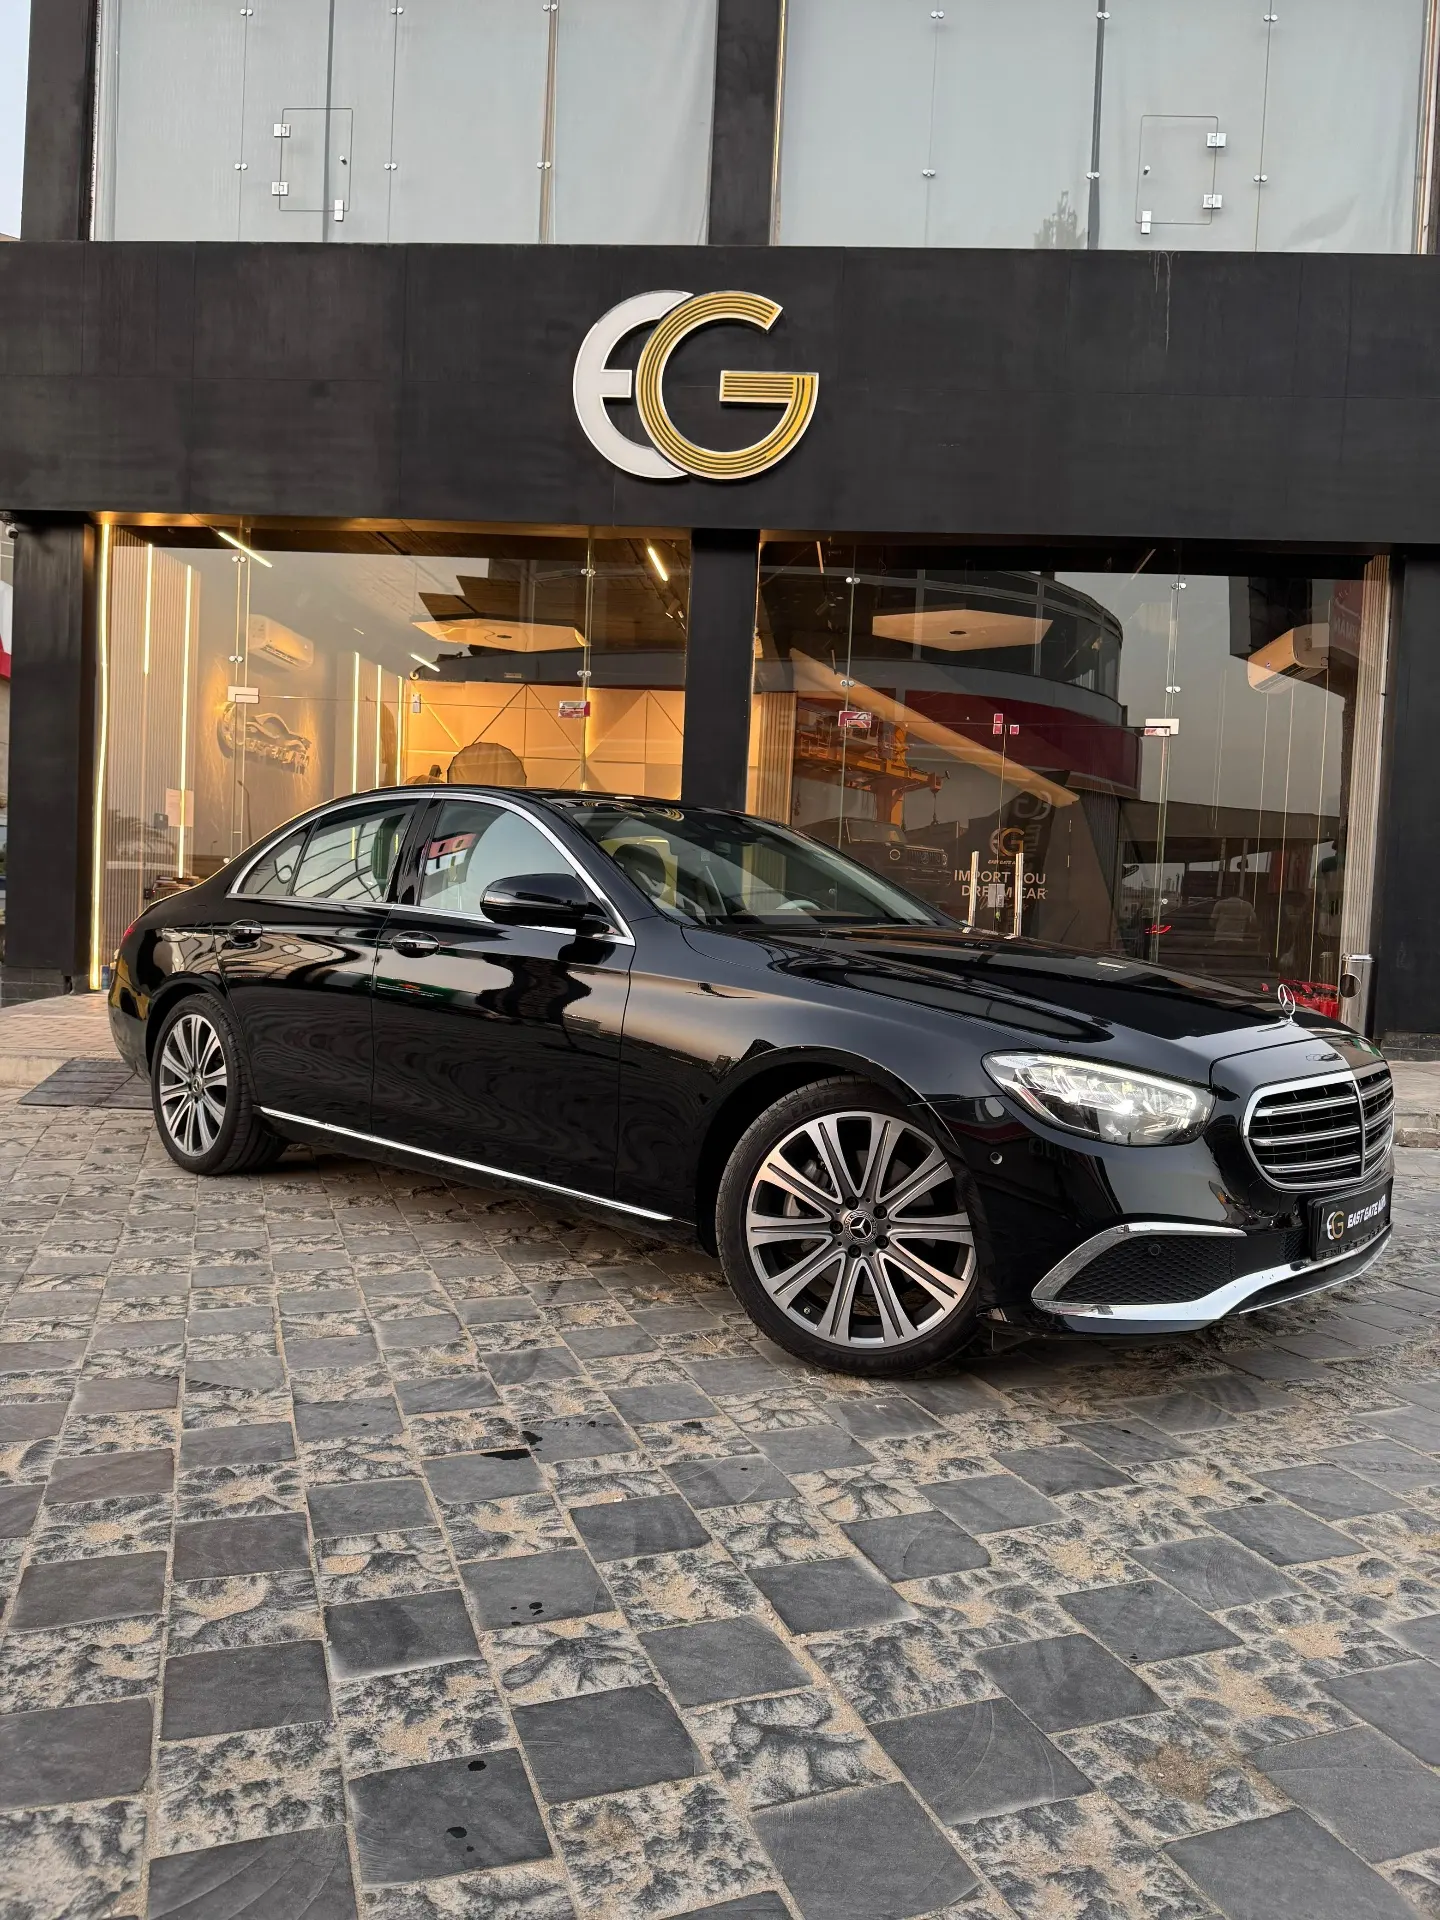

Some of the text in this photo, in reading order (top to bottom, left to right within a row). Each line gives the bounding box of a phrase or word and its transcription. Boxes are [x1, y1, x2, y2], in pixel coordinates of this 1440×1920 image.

[573, 290, 819, 480] EG
[990, 827, 1024, 857] EG
[961, 885, 1013, 898] DREM
[1326, 1210, 1345, 1240] EG
[1346, 1208, 1365, 1229] EAST
